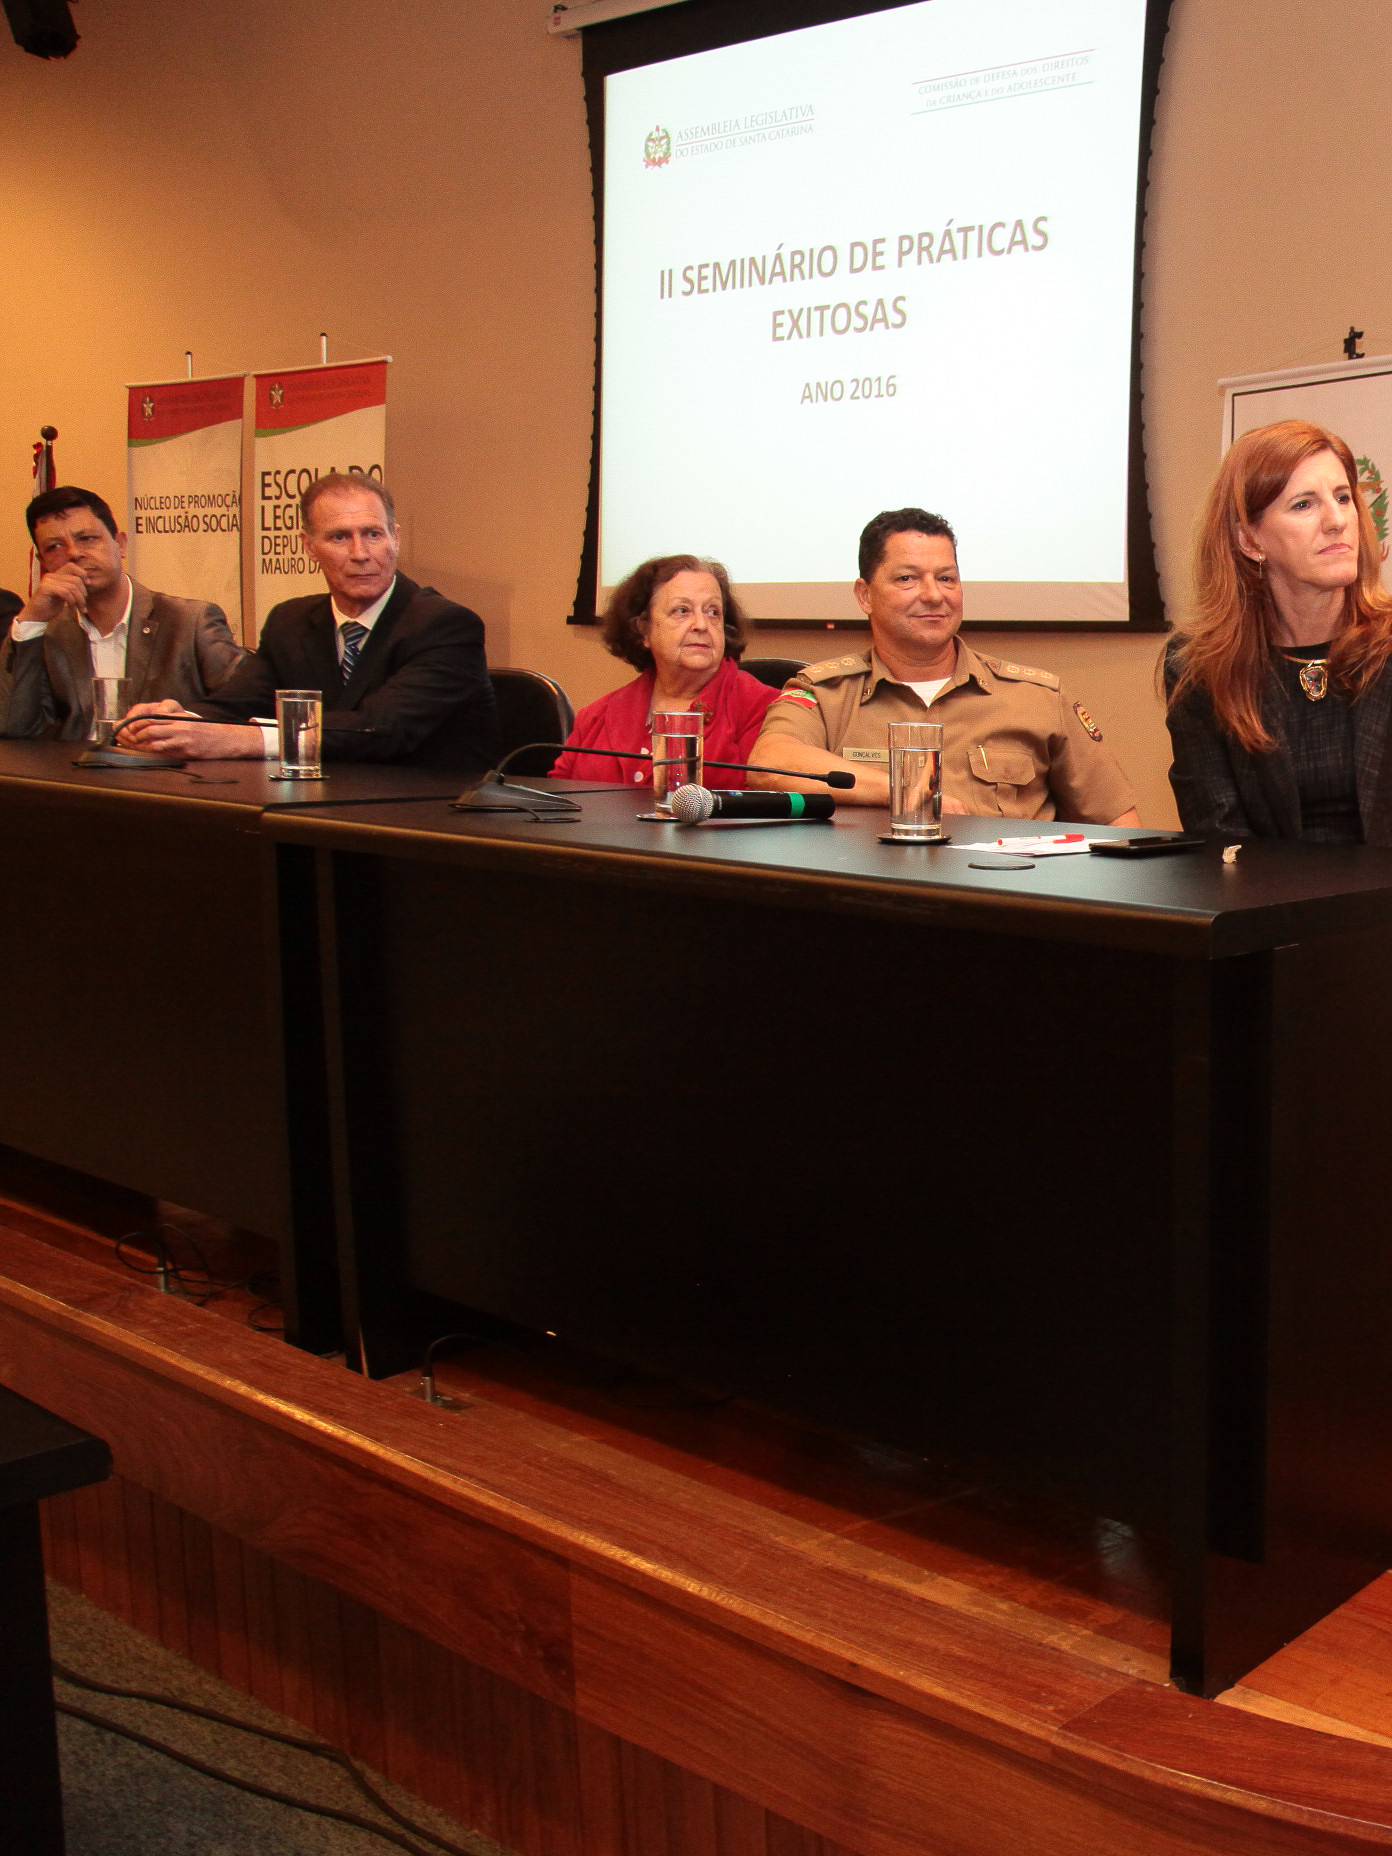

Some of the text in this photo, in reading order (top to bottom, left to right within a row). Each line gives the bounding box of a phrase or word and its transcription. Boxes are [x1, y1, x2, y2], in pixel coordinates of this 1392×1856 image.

[983, 69, 1018, 83] DEFESA
[1042, 55, 1090, 73] DIREITOS
[939, 90, 982, 105] CRIANÇA
[991, 86, 1004, 96] DO
[1006, 71, 1078, 93] ADOLESCENTE
[676, 104, 815, 142] ASSEMBLEIA LEGISLATIVA
[675, 123, 814, 159] DO ESTADO DE SANTA CATARINA
[659, 215, 1049, 300] II SEMINÁRIO DE PRÁTICAS
[772, 295, 907, 342] EXITOSAS
[800, 374, 897, 404] ANO 2016
[135, 490, 241, 512] NÚCLEO DE PROMOÇÃ
[135, 511, 240, 534] E INCLUSÃO SOCIA
[261, 557, 305, 575] MAURO
